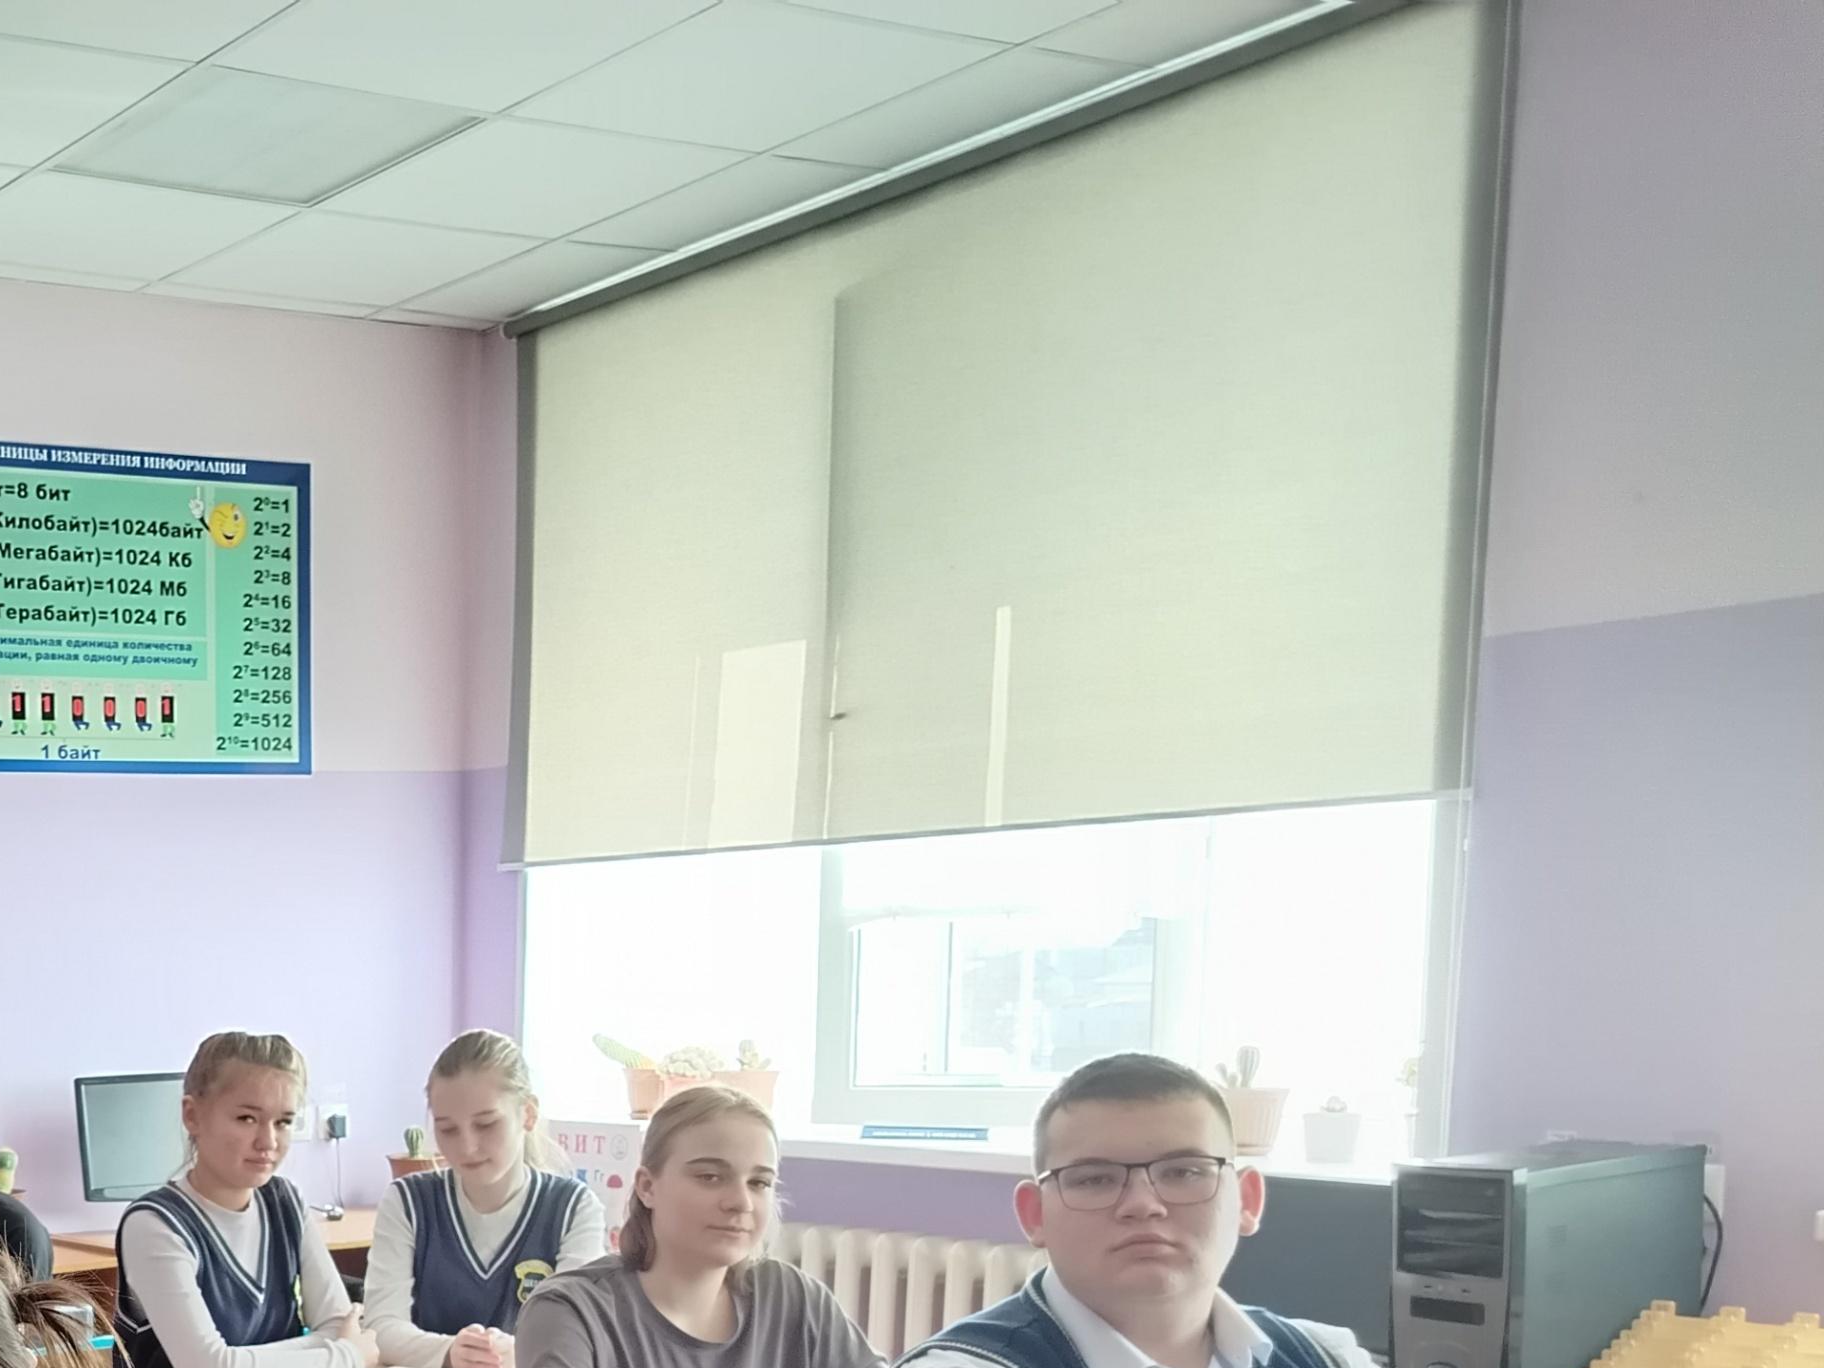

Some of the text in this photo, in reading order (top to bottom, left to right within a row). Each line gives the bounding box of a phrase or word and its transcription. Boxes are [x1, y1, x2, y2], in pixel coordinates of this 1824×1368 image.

[51, 449, 140, 468] ИЗМЕРЕНИЯ
[143, 456, 246, 476] ИНФОРМАЦИИ
[35, 485, 70, 502] бит
[168, 552, 192, 567] Кб
[159, 580, 187, 596] Мб
[164, 610, 186, 625] Гб
[65, 638, 118, 650] единица
[122, 639, 192, 651] количества
[34, 650, 79, 663] равная
[82, 652, 128, 665] одному
[131, 654, 198, 667] двоичному
[41, 744, 100, 759] 1 байт
